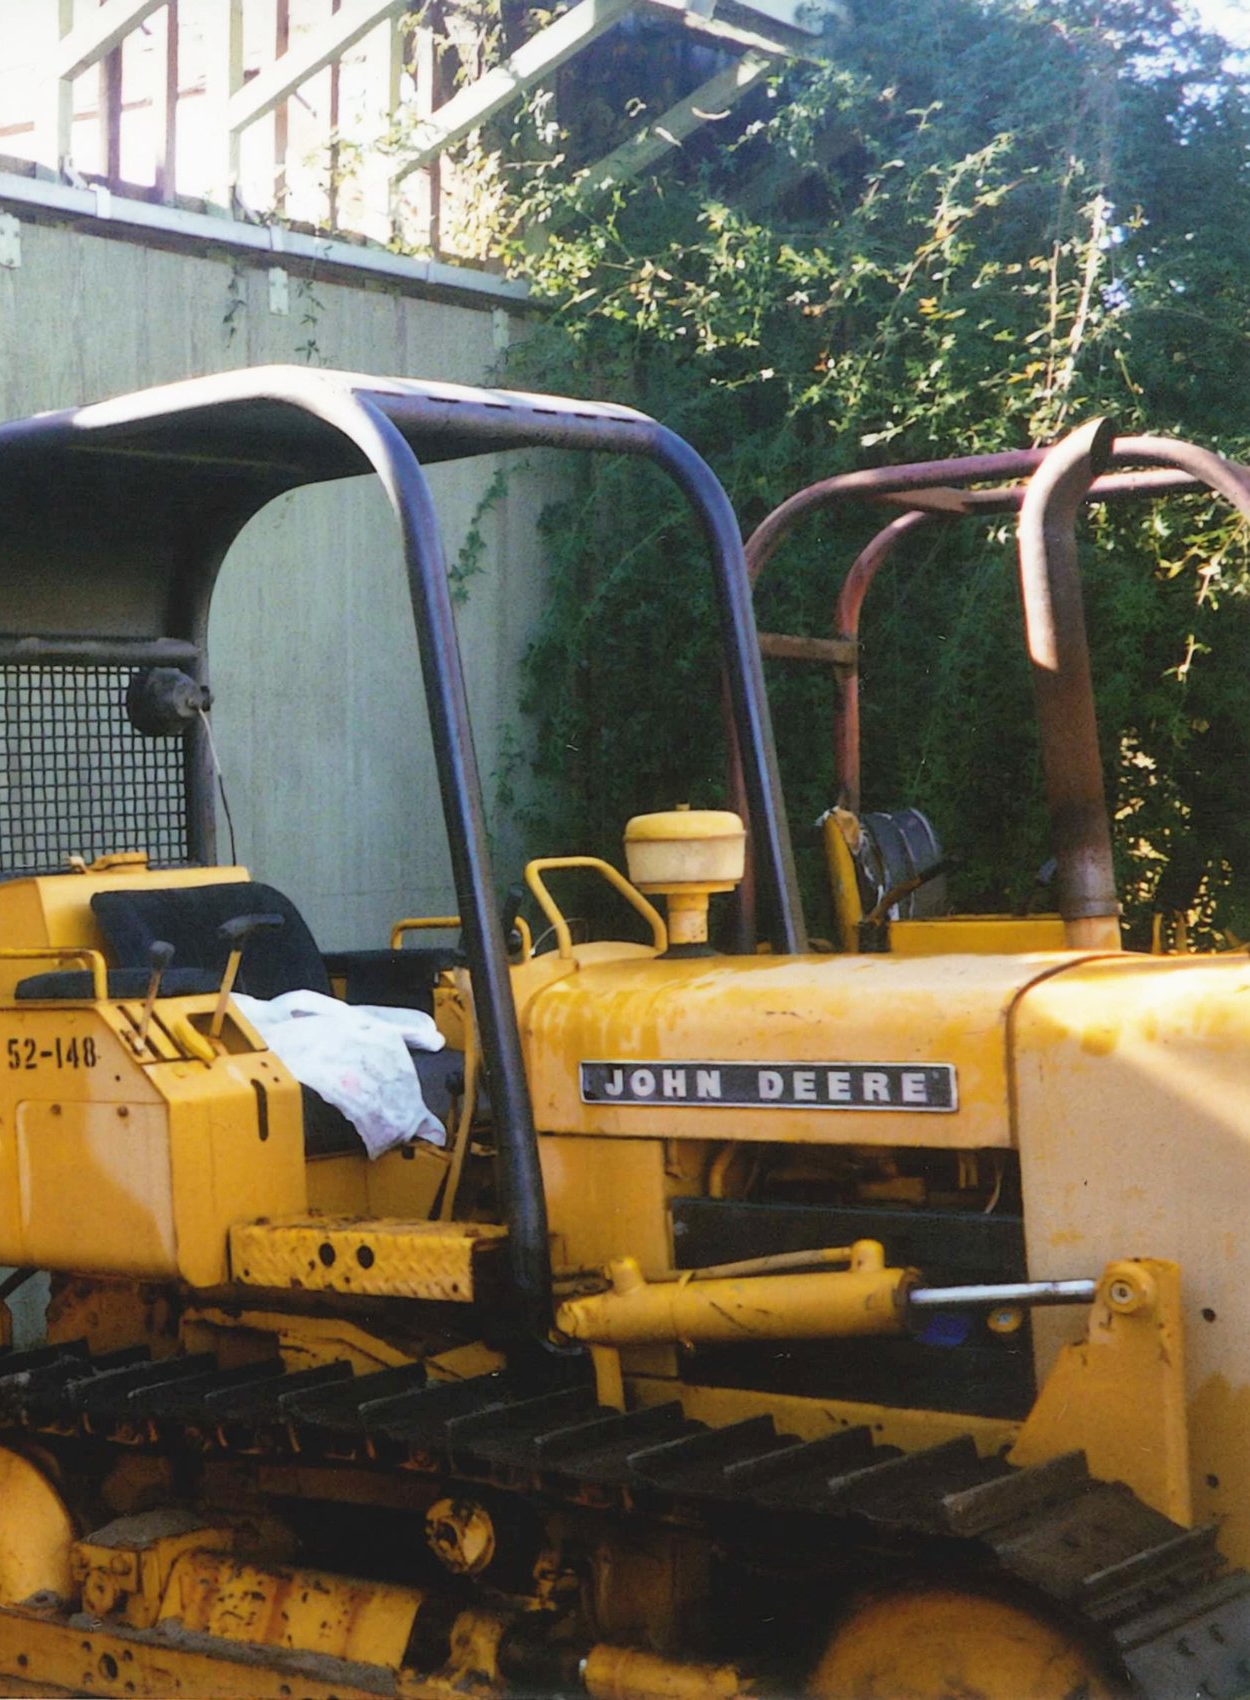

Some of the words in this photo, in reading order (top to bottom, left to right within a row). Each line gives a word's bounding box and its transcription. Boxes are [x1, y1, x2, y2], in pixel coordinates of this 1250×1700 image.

[7, 1036, 97, 1070] 52-148
[604, 1068, 722, 1099] JOHN
[757, 1070, 928, 1102] DEERE
